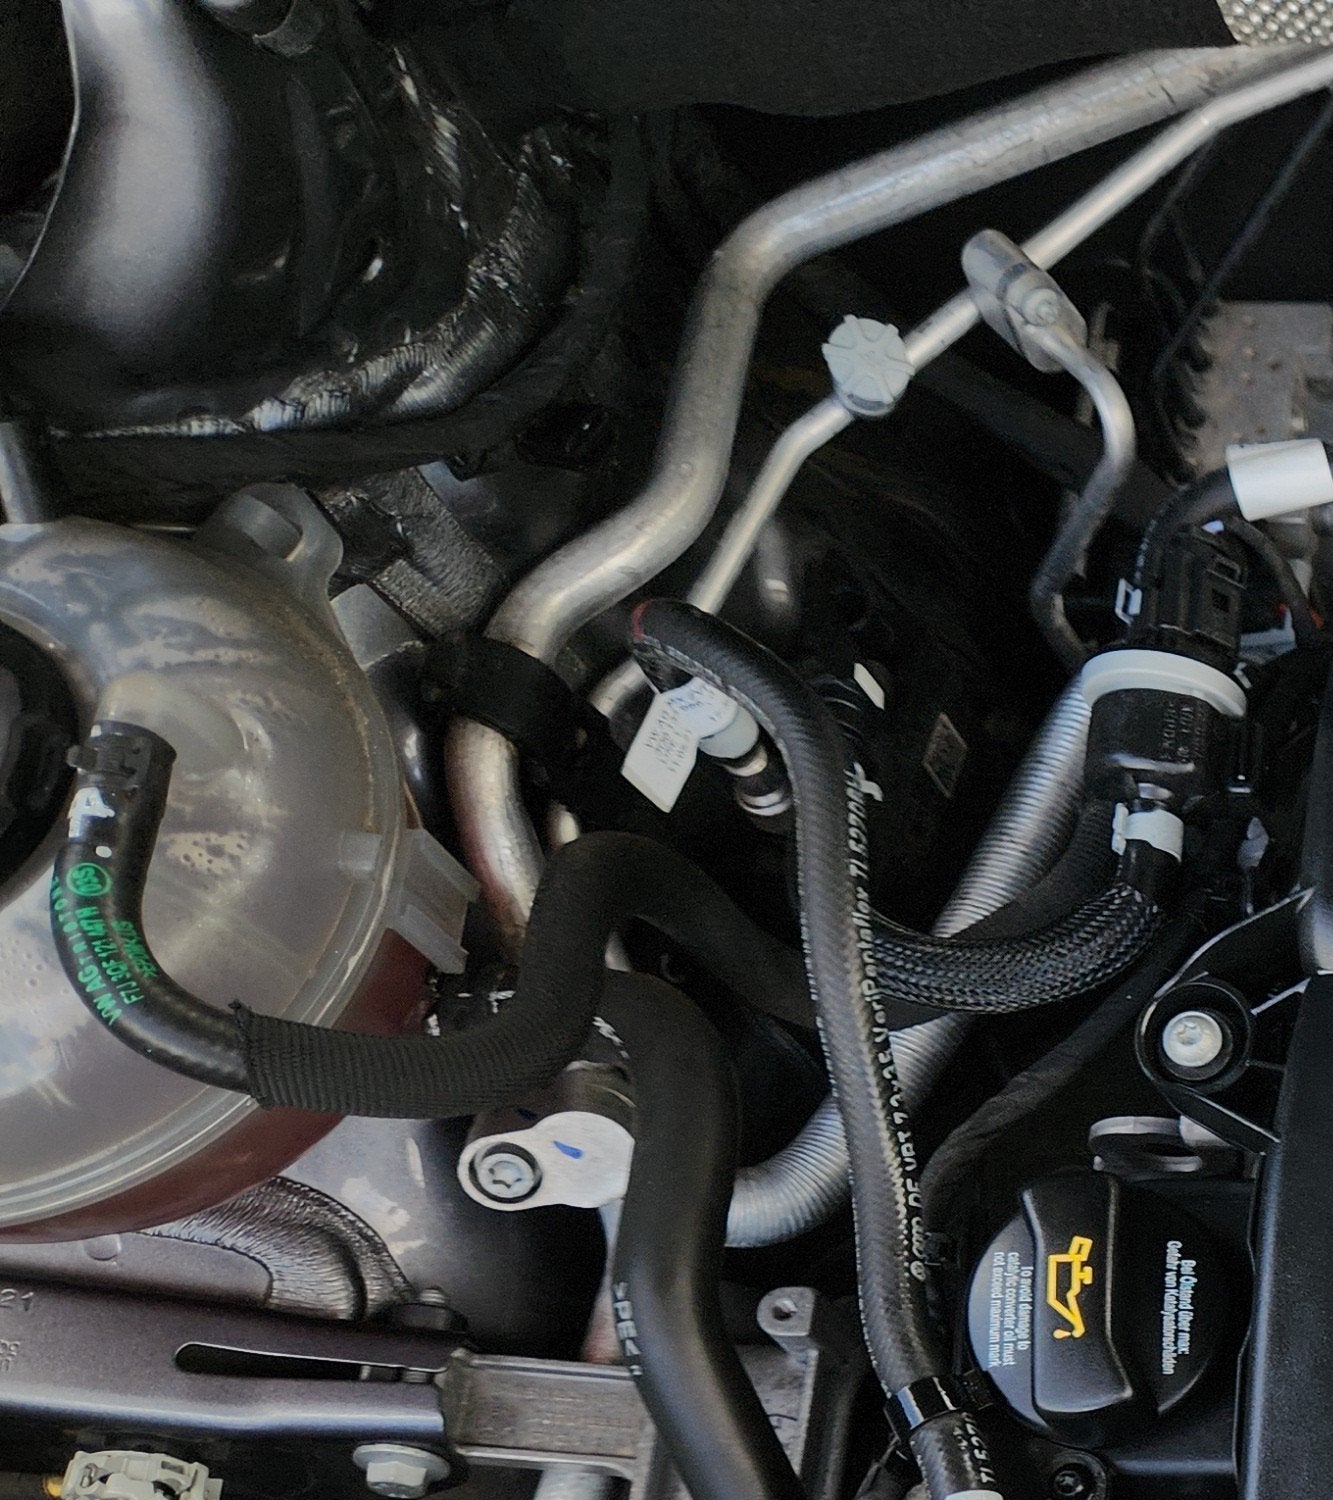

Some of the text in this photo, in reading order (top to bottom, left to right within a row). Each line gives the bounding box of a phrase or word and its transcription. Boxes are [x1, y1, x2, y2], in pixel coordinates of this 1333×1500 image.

[77, 964, 106, 993] AG
[1165, 1271, 1178, 1288] von
[1166, 1240, 1182, 1270] Gefahr
[987, 1251, 1006, 1368] not exceed maximum mark
[1002, 1252, 1020, 1367] catalytic converter oil must
[1015, 1266, 1034, 1350] To avoid damage to
